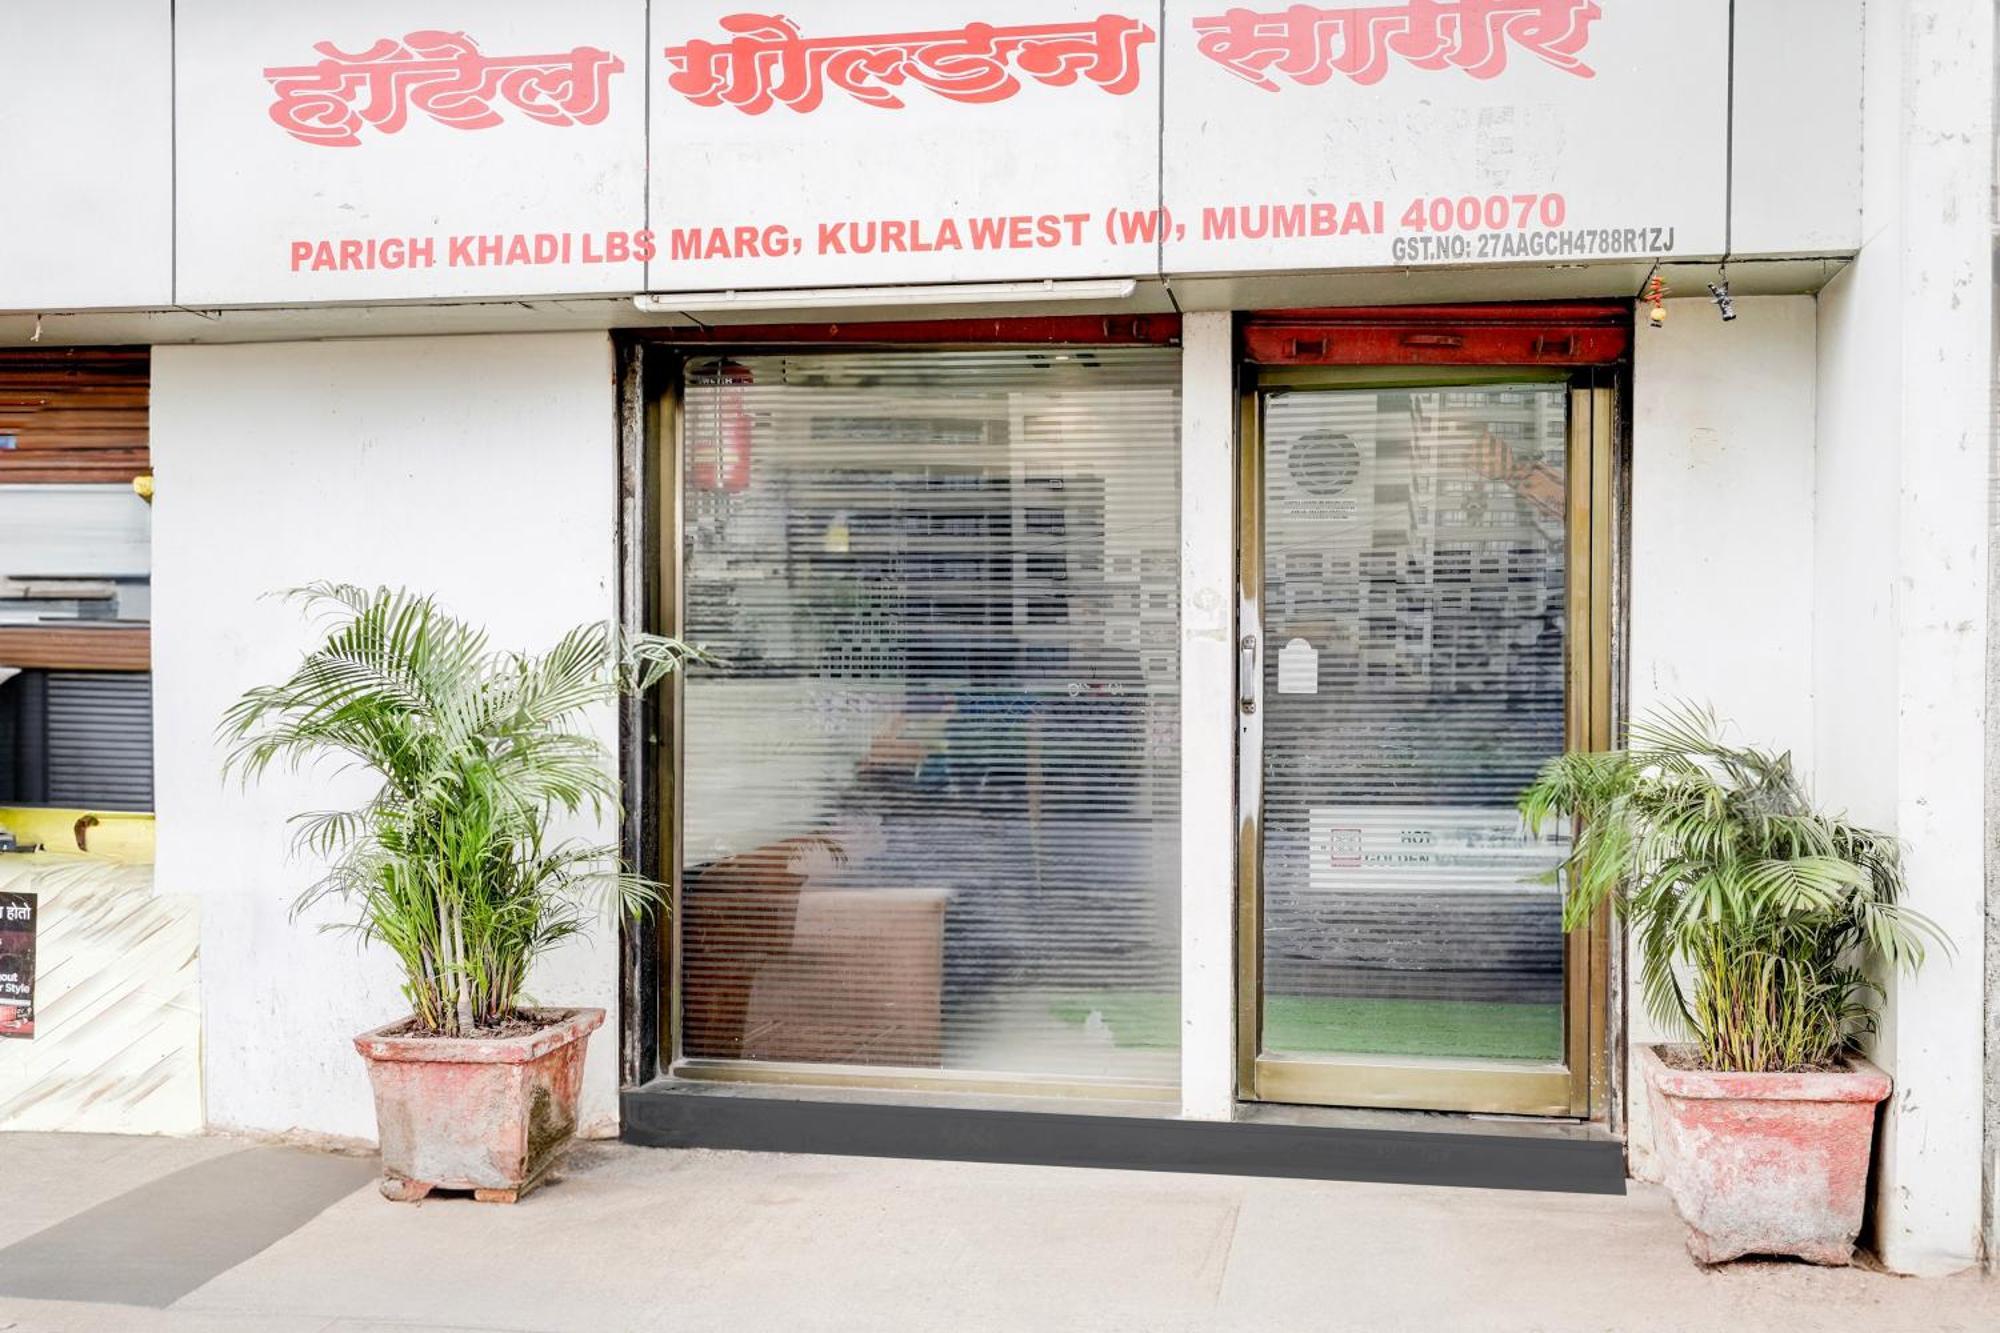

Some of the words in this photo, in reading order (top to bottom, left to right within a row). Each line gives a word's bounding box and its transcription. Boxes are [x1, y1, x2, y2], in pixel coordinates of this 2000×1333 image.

[264, 31, 625, 147] हॉटेल
[664, 12, 1156, 116] गोल्डन
[1192, 0, 1600, 92] सागर
[290, 237, 434, 272] PARIGH
[448, 232, 572, 268] KHADI
[581, 229, 657, 264] LBS
[670, 223, 803, 260] MARG,
[817, 217, 963, 256] KURLA
[968, 212, 1091, 250] WEST
[1105, 206, 1187, 245] (W),
[1202, 202, 1385, 241] MUMBAI
[1401, 193, 1566, 234] 400070
[1476, 227, 1675, 258] 27AAGCH4788R1ZJ
[5, 983, 30, 995] Style
